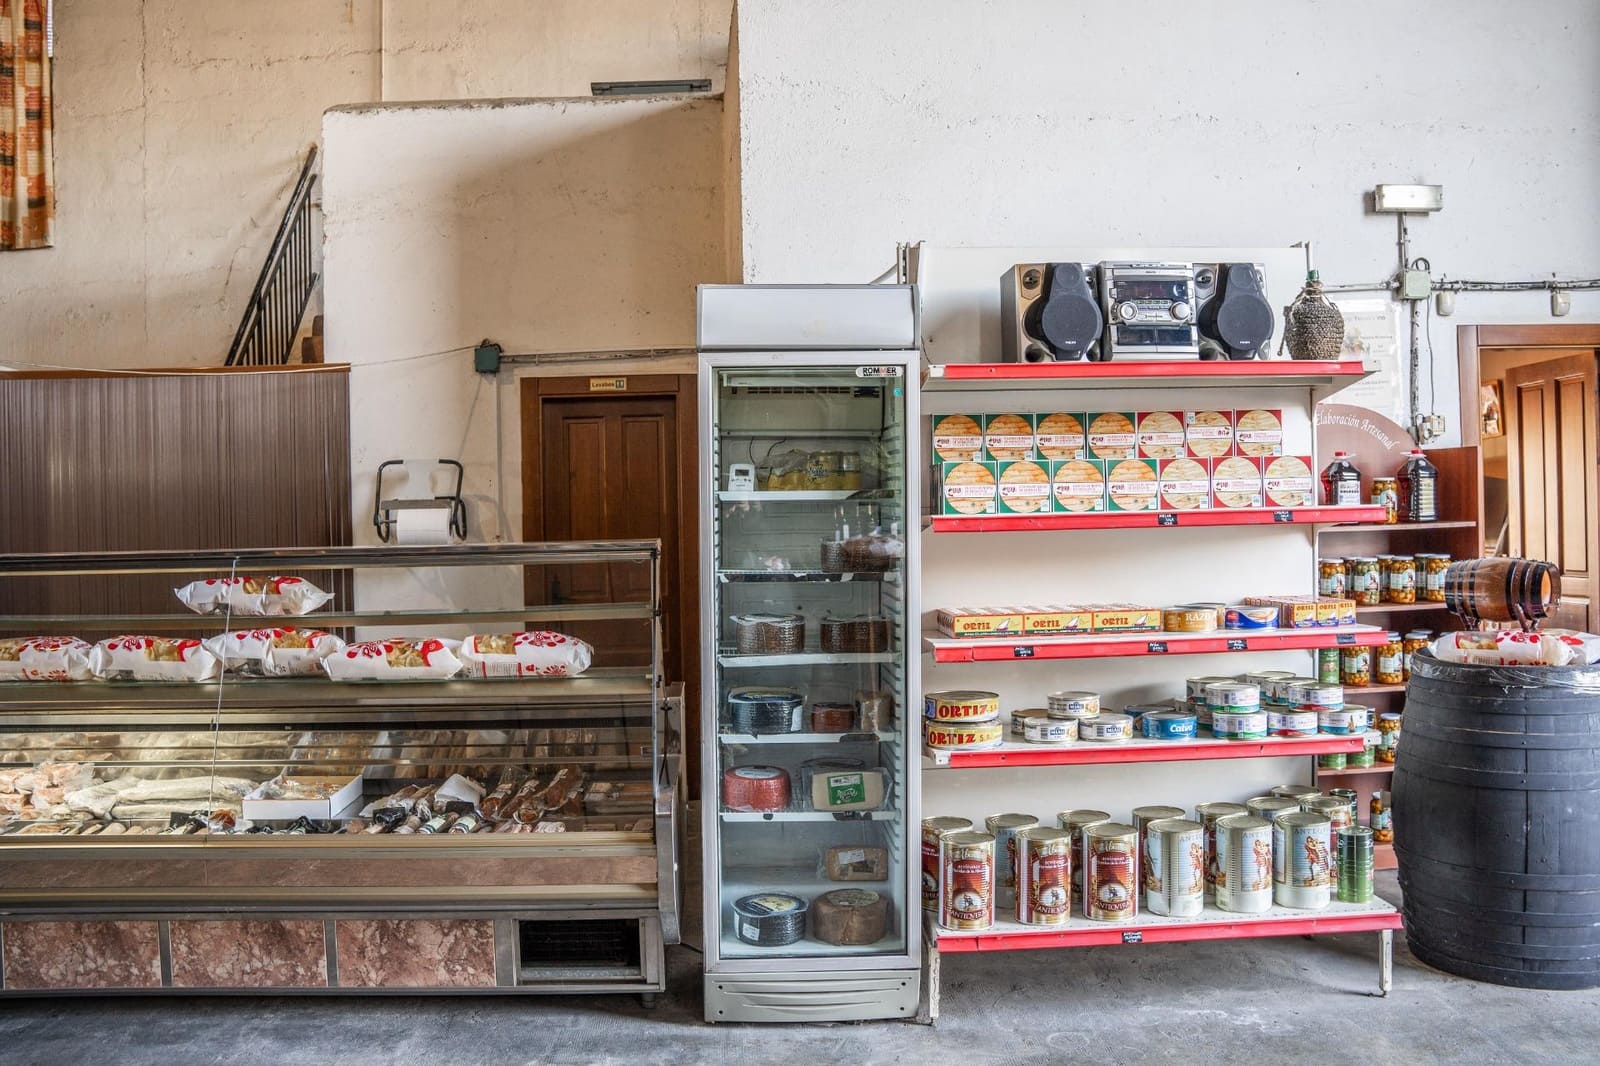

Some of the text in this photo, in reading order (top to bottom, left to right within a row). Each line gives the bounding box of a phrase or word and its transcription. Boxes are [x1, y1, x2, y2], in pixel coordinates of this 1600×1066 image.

[862, 366, 897, 374] ROMMER
[1316, 408, 1400, 450] Elaboración Artesanal
[1032, 619, 1060, 628] ORTIZ
[1101, 617, 1129, 626] ORTIZ
[962, 622, 991, 631] ORTIZ
[938, 704, 988, 718] ORTIZ
[1170, 723, 1194, 733] Calvo
[929, 731, 977, 745] ORTIZ
